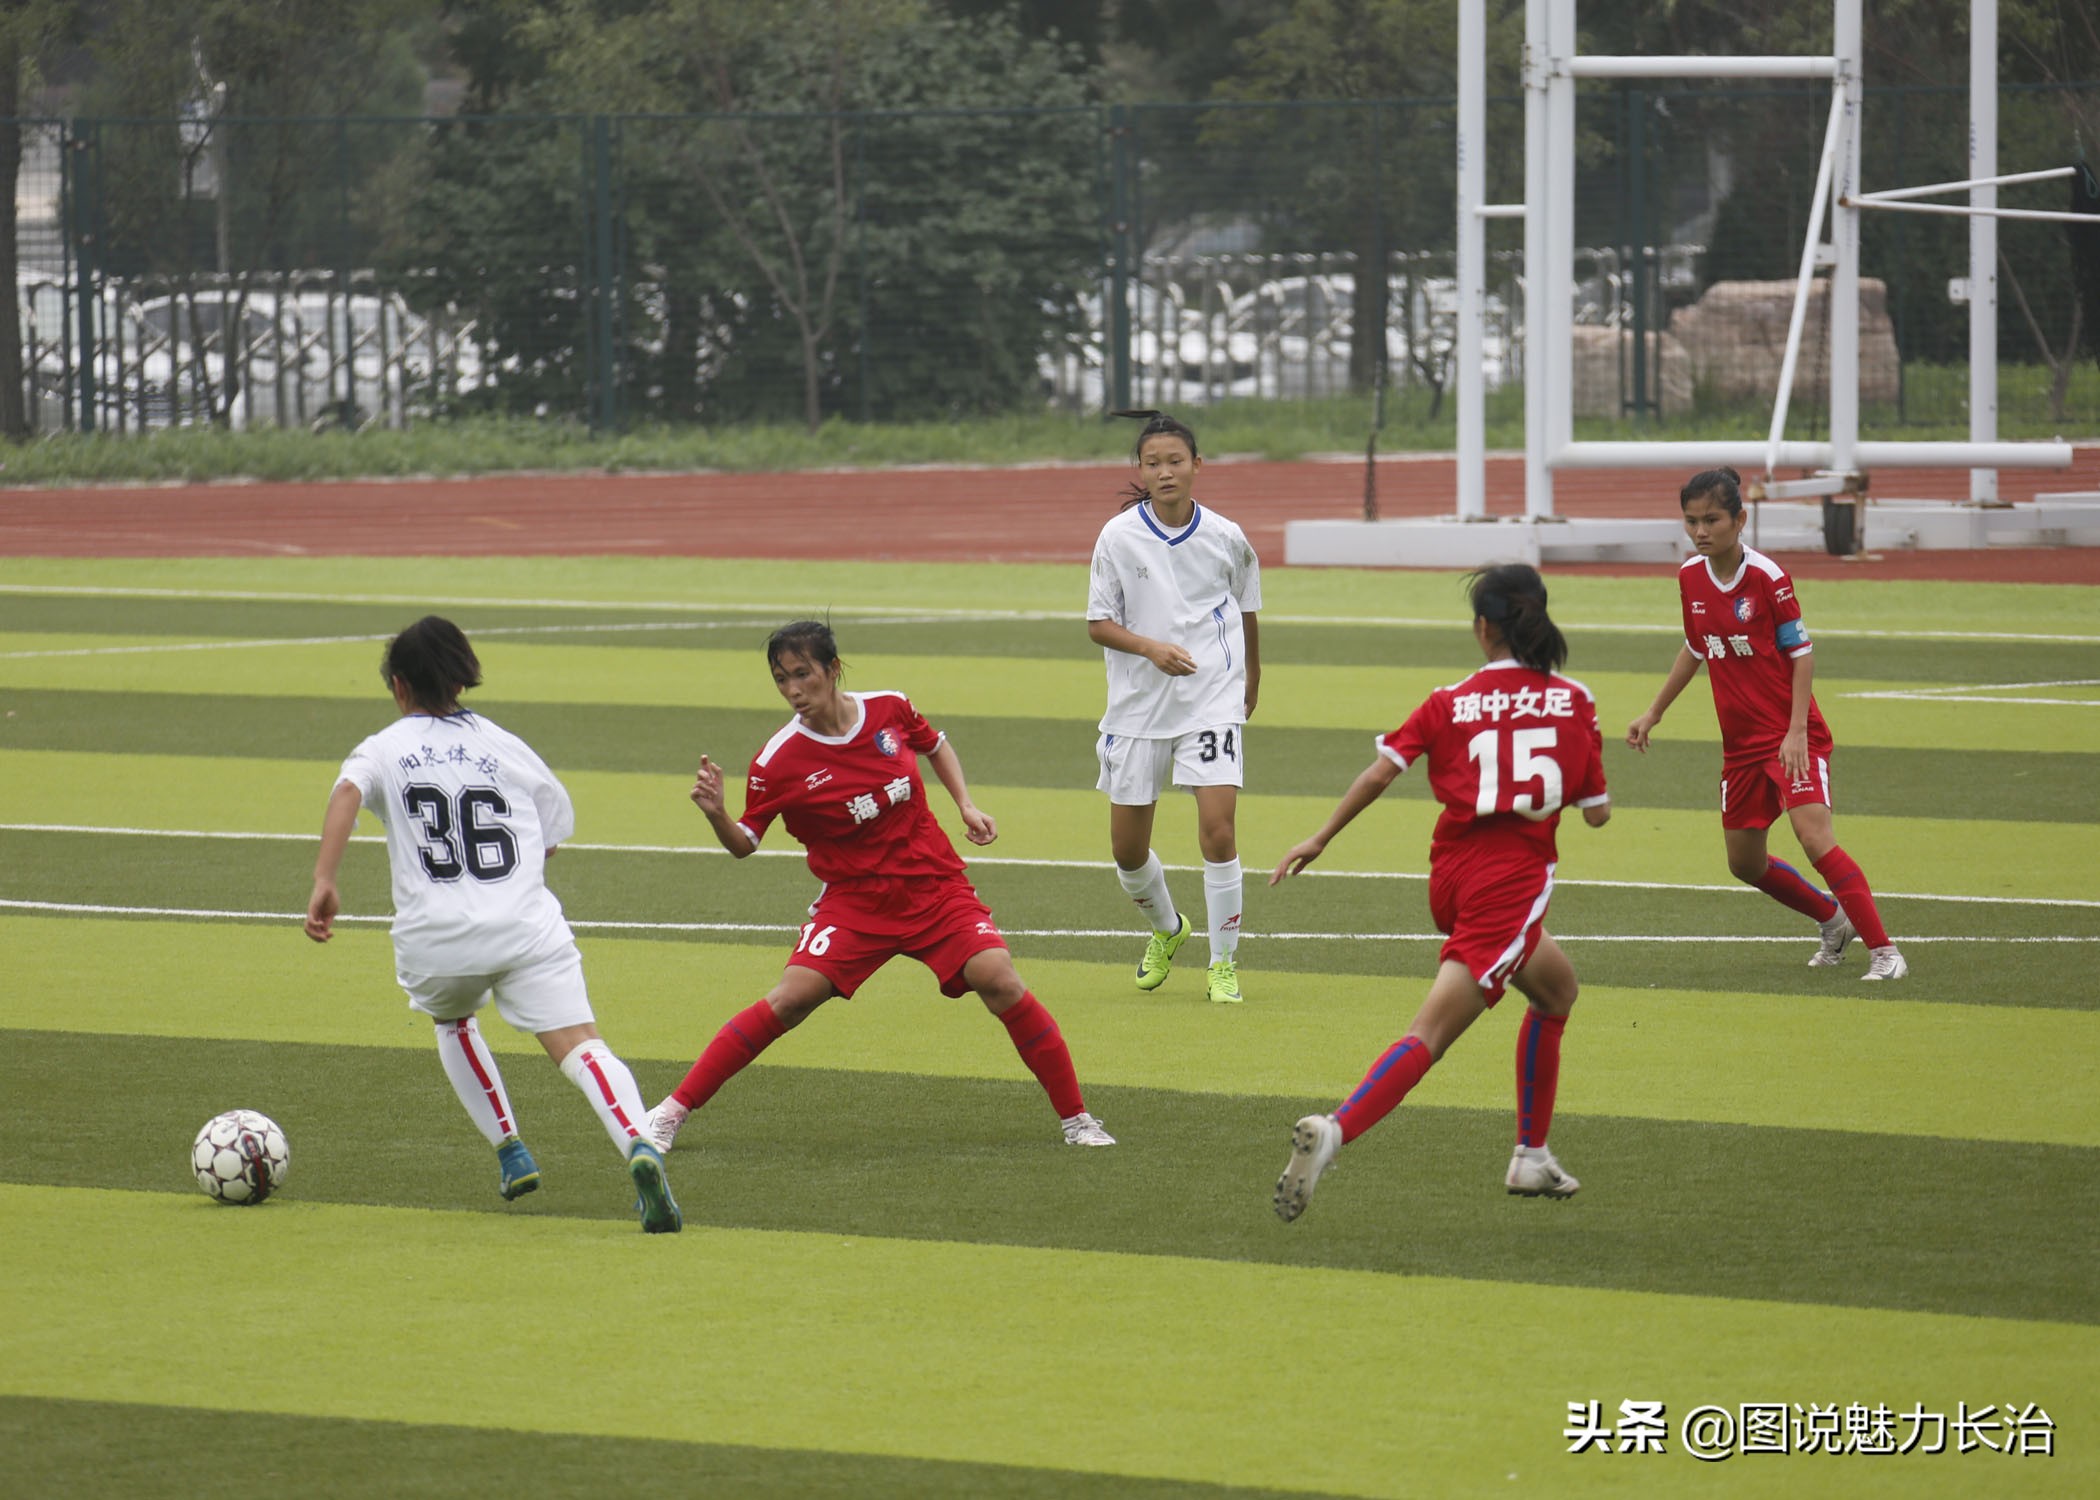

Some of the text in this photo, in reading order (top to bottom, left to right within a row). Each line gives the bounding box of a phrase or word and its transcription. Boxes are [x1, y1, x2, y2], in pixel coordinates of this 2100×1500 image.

[1703, 634, 1754, 660] 海南
[1452, 686, 1574, 724] 琼中女足
[1197, 727, 1237, 763] 34
[1468, 727, 1563, 822] 15
[846, 776, 912, 825] 海南
[402, 782, 521, 884] 36
[796, 922, 837, 956] 16
